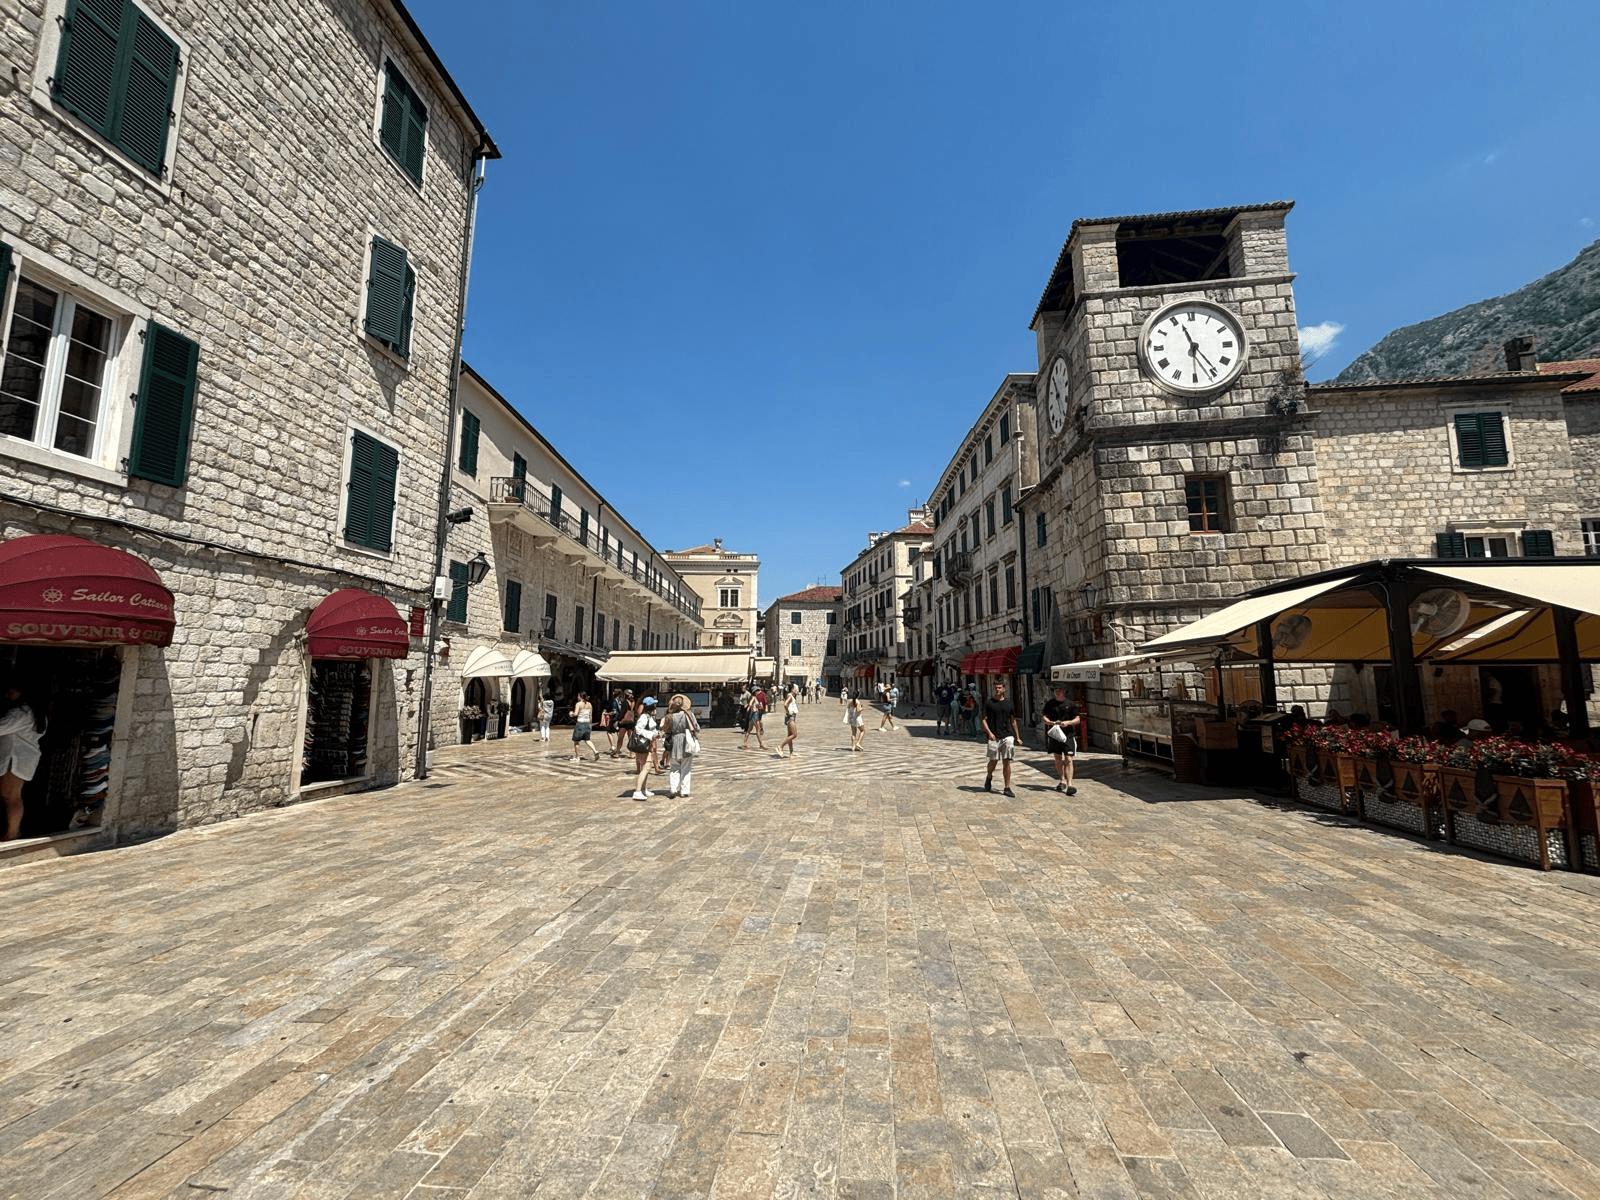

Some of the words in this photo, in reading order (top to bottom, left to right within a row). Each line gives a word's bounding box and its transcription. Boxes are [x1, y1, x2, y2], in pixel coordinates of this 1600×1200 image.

[71, 588, 124, 603] Sailor
[7, 623, 124, 639] SOUVENIR
[128, 627, 141, 639] &
[370, 626, 392, 634] Sailor
[338, 646, 393, 656] SOUVENIR
